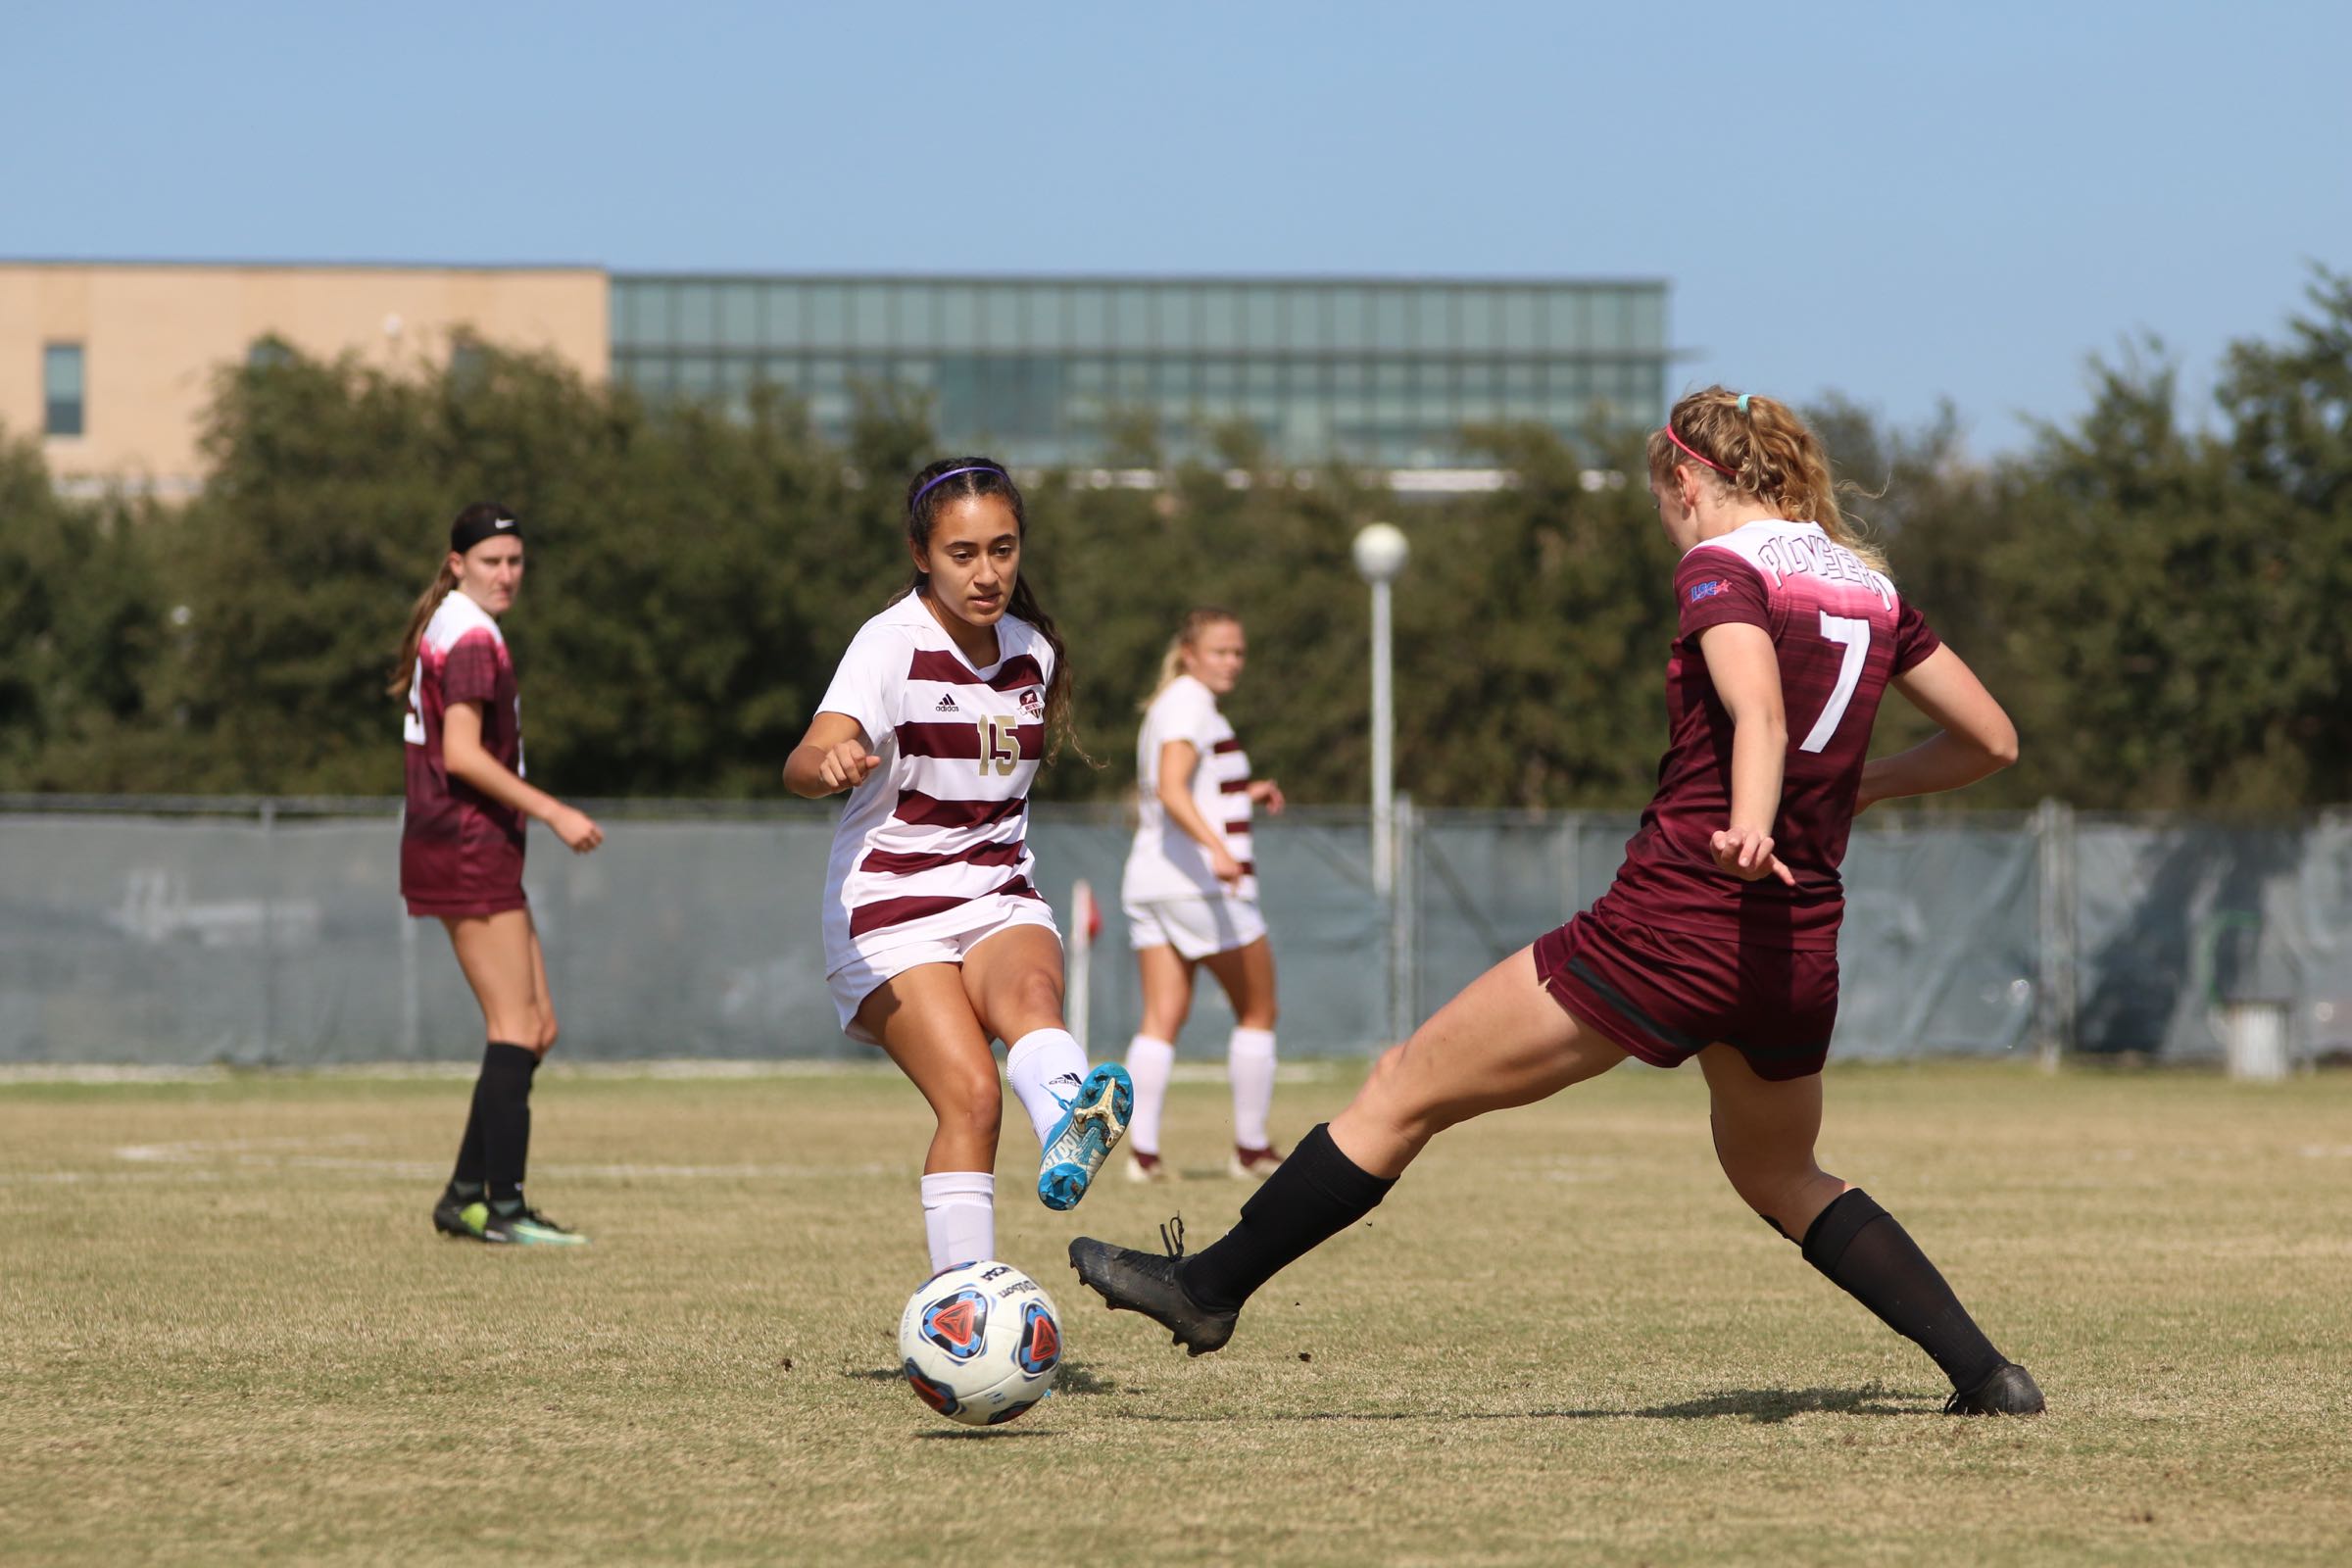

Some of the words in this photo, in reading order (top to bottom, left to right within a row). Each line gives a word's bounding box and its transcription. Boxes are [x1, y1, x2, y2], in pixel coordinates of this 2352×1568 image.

[1799, 610, 1871, 754] 7
[977, 714, 1021, 776] 15
[998, 1280, 1037, 1298] Wilson
